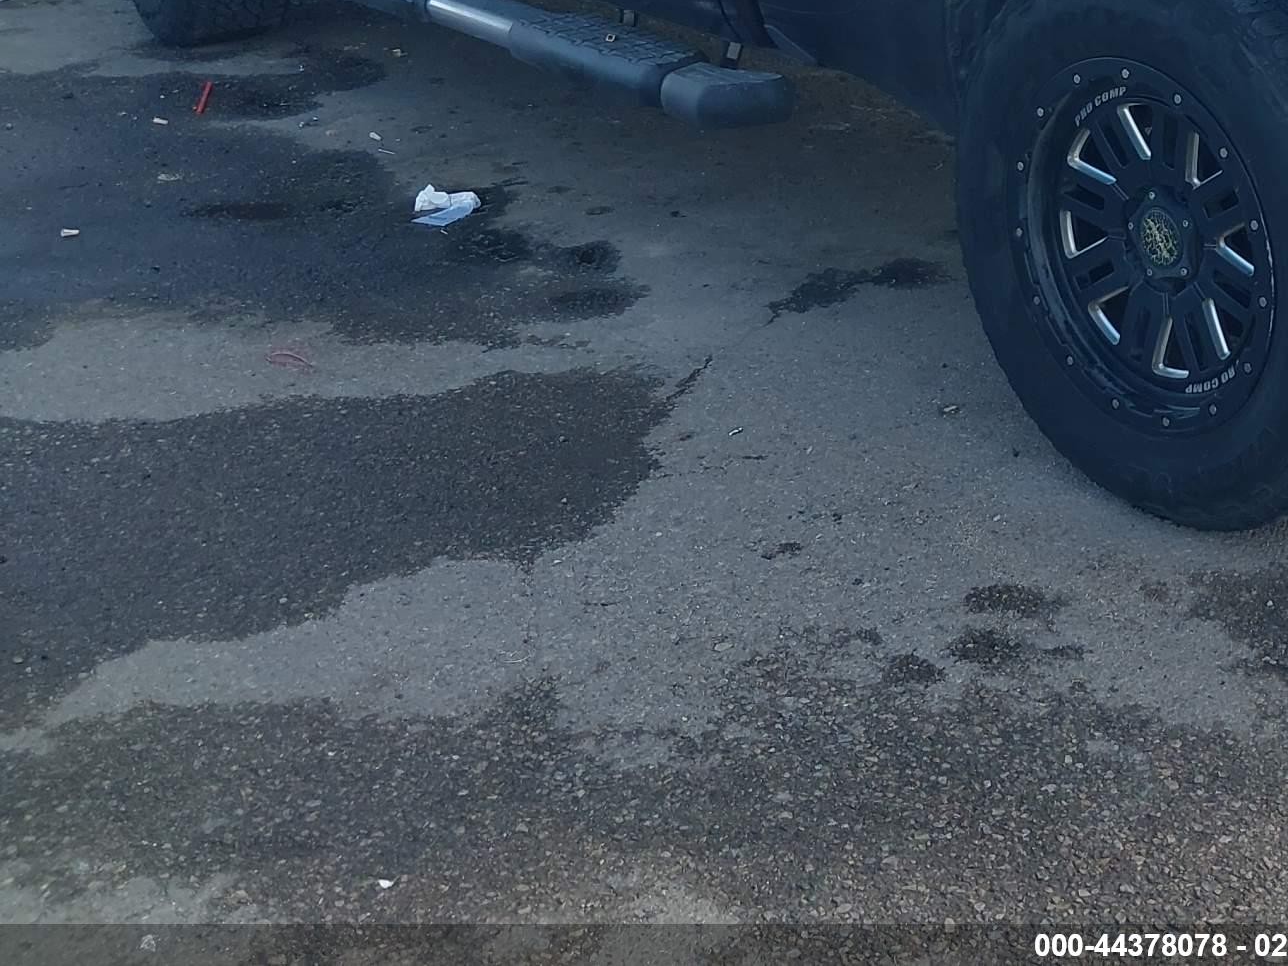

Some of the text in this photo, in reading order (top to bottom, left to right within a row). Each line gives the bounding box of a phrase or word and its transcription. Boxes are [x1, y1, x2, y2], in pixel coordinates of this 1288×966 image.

[1075, 86, 1127, 127] PRO COMP
[1185, 377, 1219, 394] COMP
